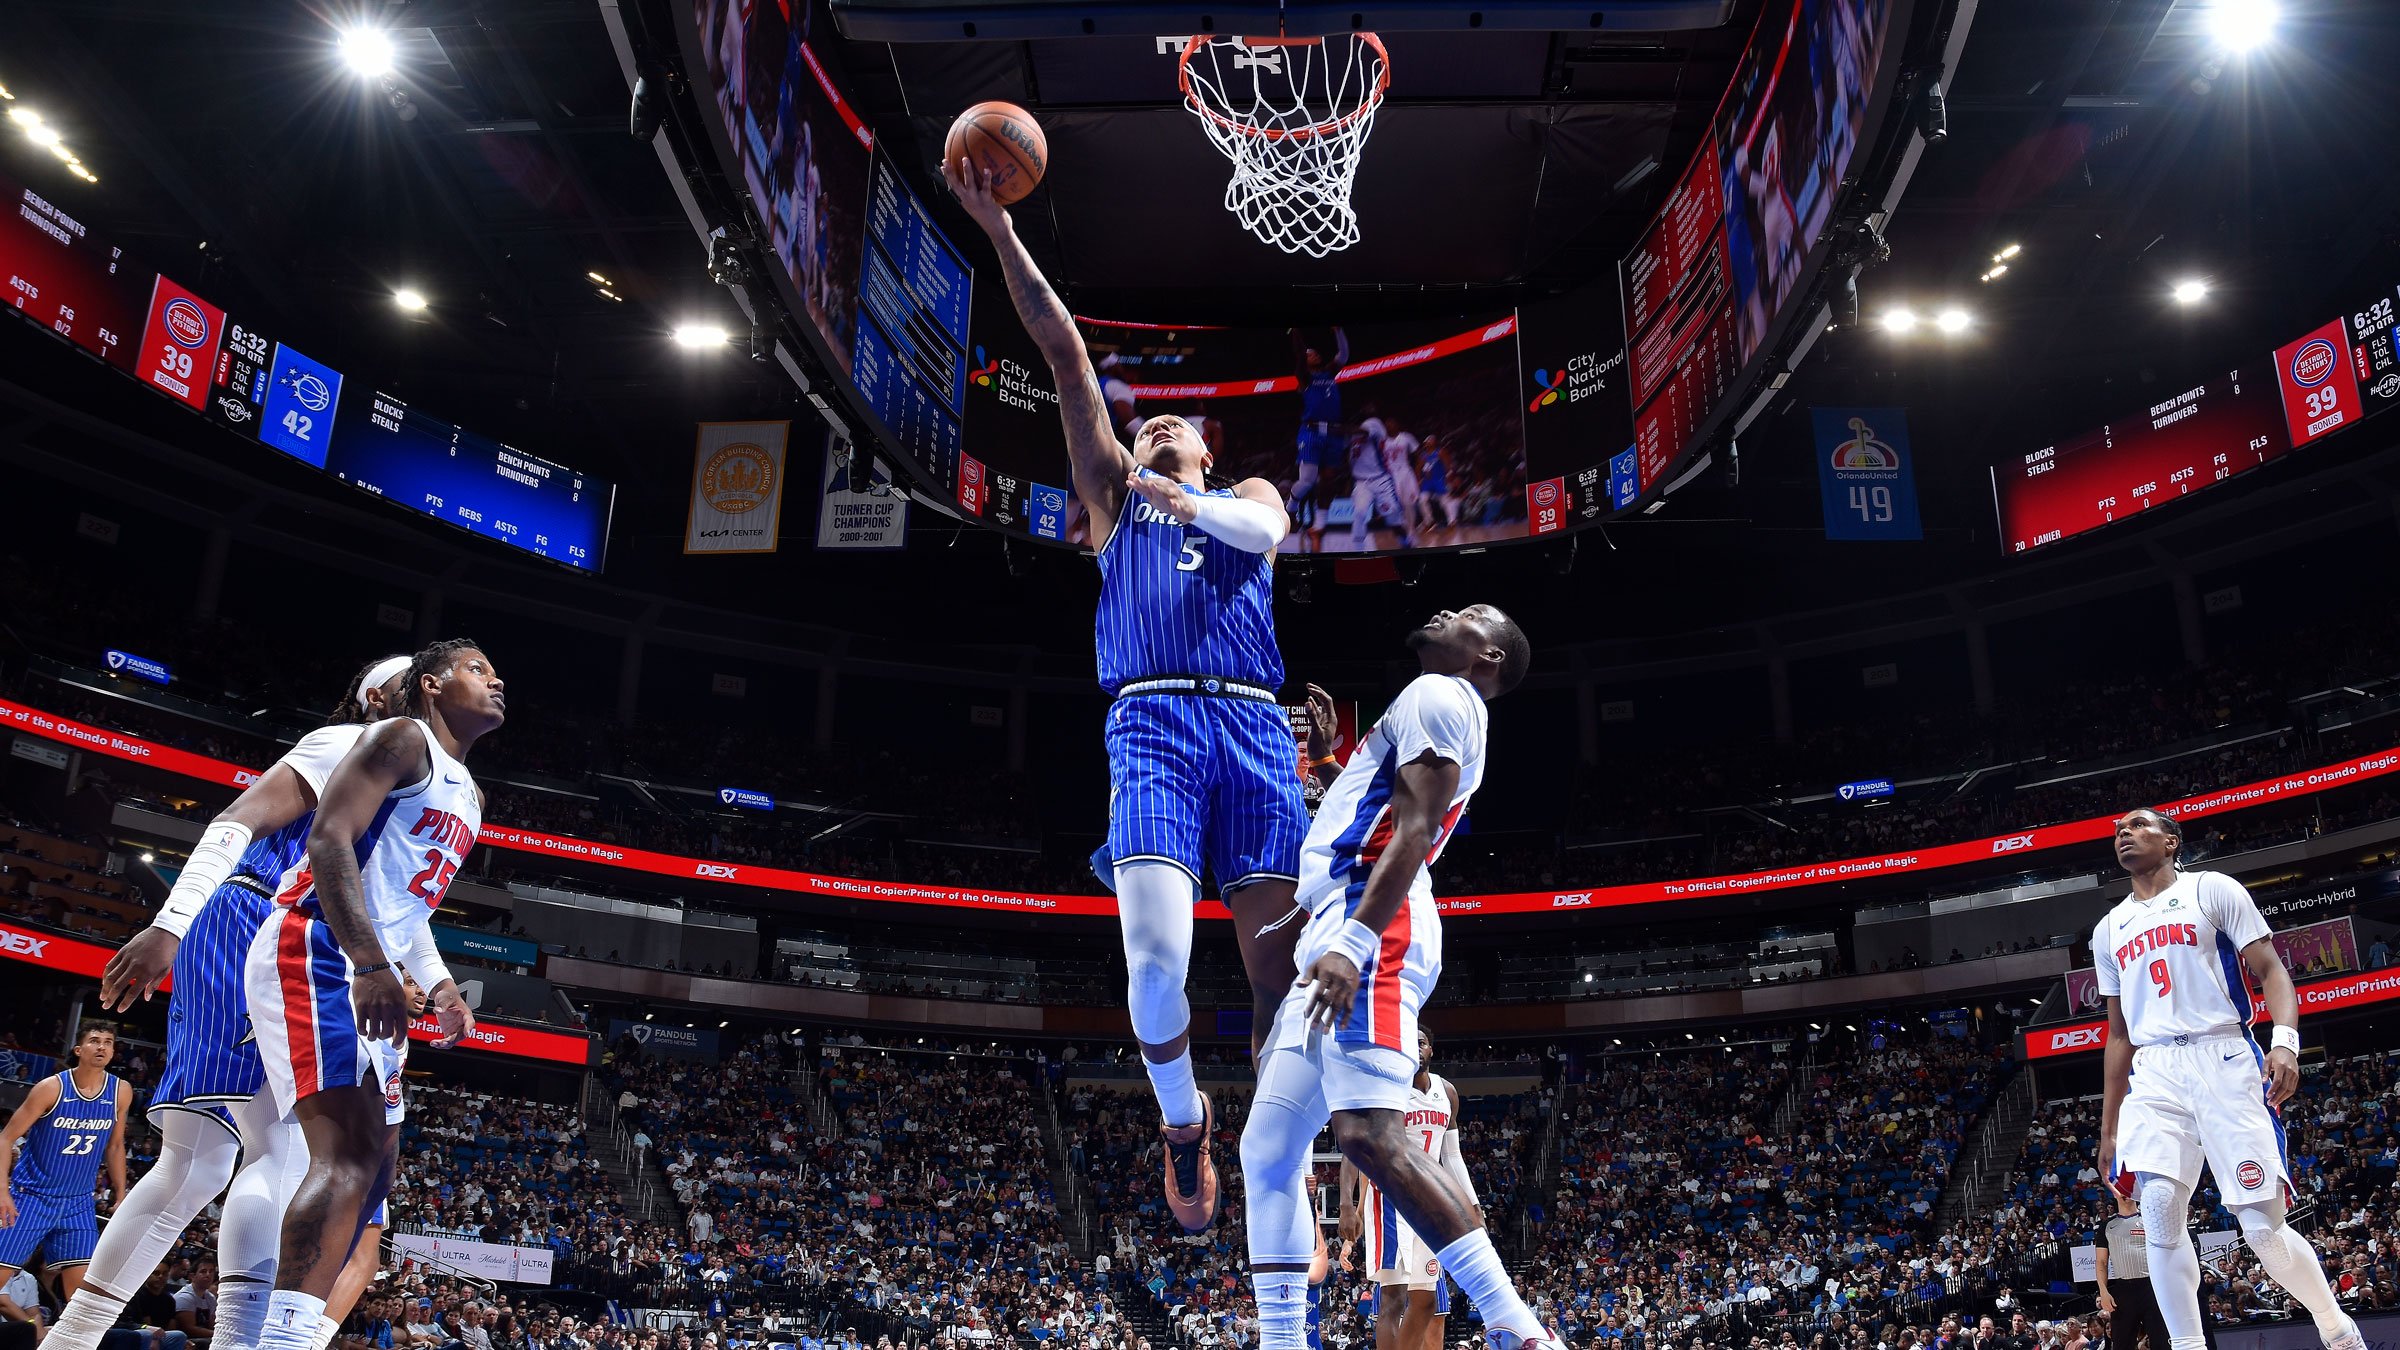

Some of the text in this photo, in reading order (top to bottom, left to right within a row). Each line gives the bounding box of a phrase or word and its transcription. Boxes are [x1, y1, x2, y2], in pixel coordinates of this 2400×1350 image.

[1001, 119, 1044, 175] Wilson
[23, 188, 86, 237] BENCH POINTS
[19, 204, 72, 246] TURNOVERS
[112, 246, 122, 259] 17
[9, 275, 118, 346] ASTS FG FLS
[174, 309, 201, 329] DETROIT
[2354, 298, 2393, 330] 6:32
[54, 319, 72, 336] 0/2
[172, 317, 199, 337] PISTONS
[2357, 314, 2394, 340] 2ND QTR
[231, 324, 268, 356] 6:32
[2372, 335, 2387, 350] FLS
[160, 344, 193, 379] 39
[229, 341, 264, 365] 2ND QTR
[1567, 352, 1596, 372] City
[2300, 351, 2326, 368] DETROIT
[2373, 346, 2390, 360] TOL
[236, 361, 251, 375] FLS
[1000, 358, 1031, 381] City
[1569, 349, 1624, 388] National
[2301, 357, 2328, 376] PISTONS
[2375, 357, 2393, 371] CHL
[158, 374, 186, 394] BONUS
[234, 371, 249, 385] TOL
[2230, 369, 2238, 382] 17
[232, 381, 247, 396] CHL
[1000, 372, 1059, 405] Nationa
[1570, 378, 1606, 403] Bank
[2234, 384, 2241, 395] 8
[2370, 380, 2388, 396] Hard
[217, 396, 252, 421] Hard Rock
[373, 399, 404, 420] BLOCKS
[999, 388, 1037, 413] Bank
[2150, 385, 2206, 417] BENCH POINTS
[2305, 385, 2337, 418] 39
[282, 409, 313, 441] 42
[371, 413, 400, 433] STEALS
[2152, 403, 2198, 430] TURNOVERS
[2312, 414, 2339, 433] BONUS
[452, 433, 459, 444] 2
[2104, 425, 2110, 435] 2
[2106, 438, 2112, 449] 5
[498, 451, 524, 470] BENCH
[523, 461, 551, 479] POINTS
[2025, 446, 2055, 465] BLOCKS
[496, 464, 540, 489] TURNOVERS
[707, 453, 726, 477] GREEN
[727, 446, 763, 461] BUILDING
[760, 457, 771, 492] COUNCIL
[1578, 469, 1598, 483] 6:32
[1836, 472, 1898, 480] OrlandoUnited
[2027, 460, 2055, 477] STEALS
[2098, 435, 2268, 511] PTS REBS ASTS FG FLS
[573, 479, 582, 490] 10
[997, 475, 1016, 489] 6:32
[1621, 478, 1634, 495] 42
[963, 485, 976, 502] 39
[2106, 466, 2230, 522] 0 0/2
[721, 501, 750, 511] USGBC
[834, 503, 894, 517] TURNER CUP
[1849, 486, 1893, 522] 49
[426, 493, 586, 559] PTS REBS ASTS FG FLS
[834, 516, 891, 529] CHAMPIONS
[1039, 514, 1056, 529] 42
[1538, 509, 1556, 524] 39
[732, 529, 764, 537] CENTER
[839, 532, 883, 543] 2000-2001
[2015, 529, 2062, 552] 20 LANIER
[1176, 536, 1208, 572] 5
[127, 658, 166, 675] FANDUEL
[15, 712, 151, 757] of the Orlando Magic
[1856, 781, 1890, 792] FANDUEL
[2183, 788, 2265, 812] Copier/Printer
[2268, 783, 2281, 794] of
[2283, 778, 2305, 790] the
[2307, 766, 2357, 785] Orlando
[2359, 755, 2398, 772] Magic
[738, 792, 770, 803] FANDUEL
[509, 834, 520, 842] of
[523, 836, 541, 846] the
[545, 839, 588, 854] Orlando
[591, 847, 623, 860] Magic
[1992, 834, 2036, 854] DEX
[407, 848, 458, 910] 25
[695, 863, 738, 879] DEX
[1664, 856, 1918, 895] The Official Copier/Printer of the Orlando Magic
[810, 878, 1057, 908] The Official Copier/Printer of the Orlando Magic
[1552, 892, 1593, 907] DEX
[2280, 887, 2356, 913] Turbo-Hybrid
[1450, 900, 1482, 911] Magic
[2116, 922, 2198, 972] PISTONS
[2149, 958, 2172, 998] 9
[408, 1019, 443, 1034] Orlan
[654, 1029, 698, 1042] FANDUEL
[2051, 1026, 2103, 1049] DEX
[1404, 1109, 1450, 1128] PISTONS
[62, 1134, 98, 1156] 23
[1421, 1130, 1433, 1154] 7
[441, 1250, 471, 1261] ULTRA
[521, 1259, 549, 1269] ULTRA
